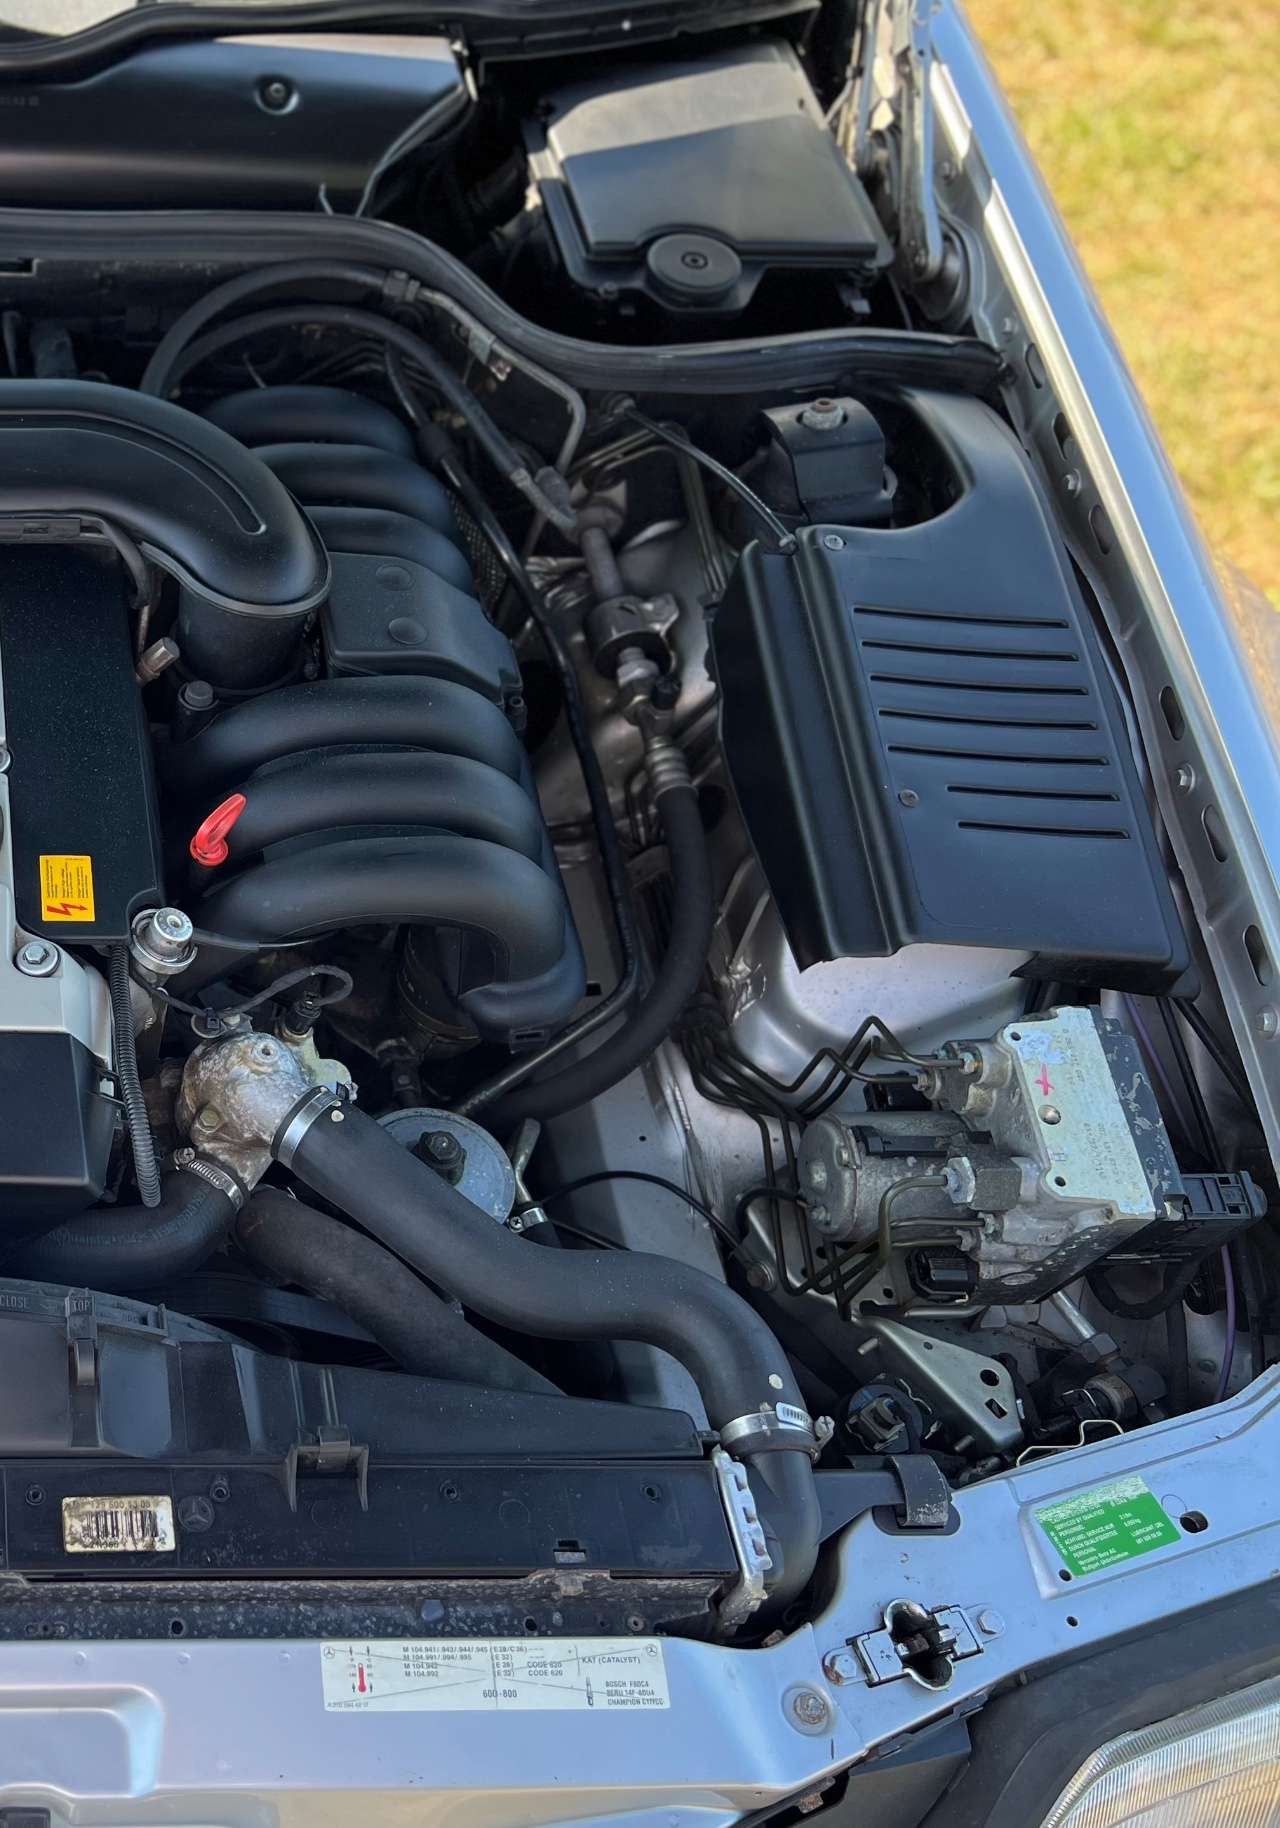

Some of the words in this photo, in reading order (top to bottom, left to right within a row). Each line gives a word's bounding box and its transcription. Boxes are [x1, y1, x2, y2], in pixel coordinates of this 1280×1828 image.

[71, 1298, 91, 1313] TOP
[527, 1660, 549, 1669] CODE
[528, 1669, 550, 1677] CODE
[607, 1698, 641, 1706] CHAMPION
